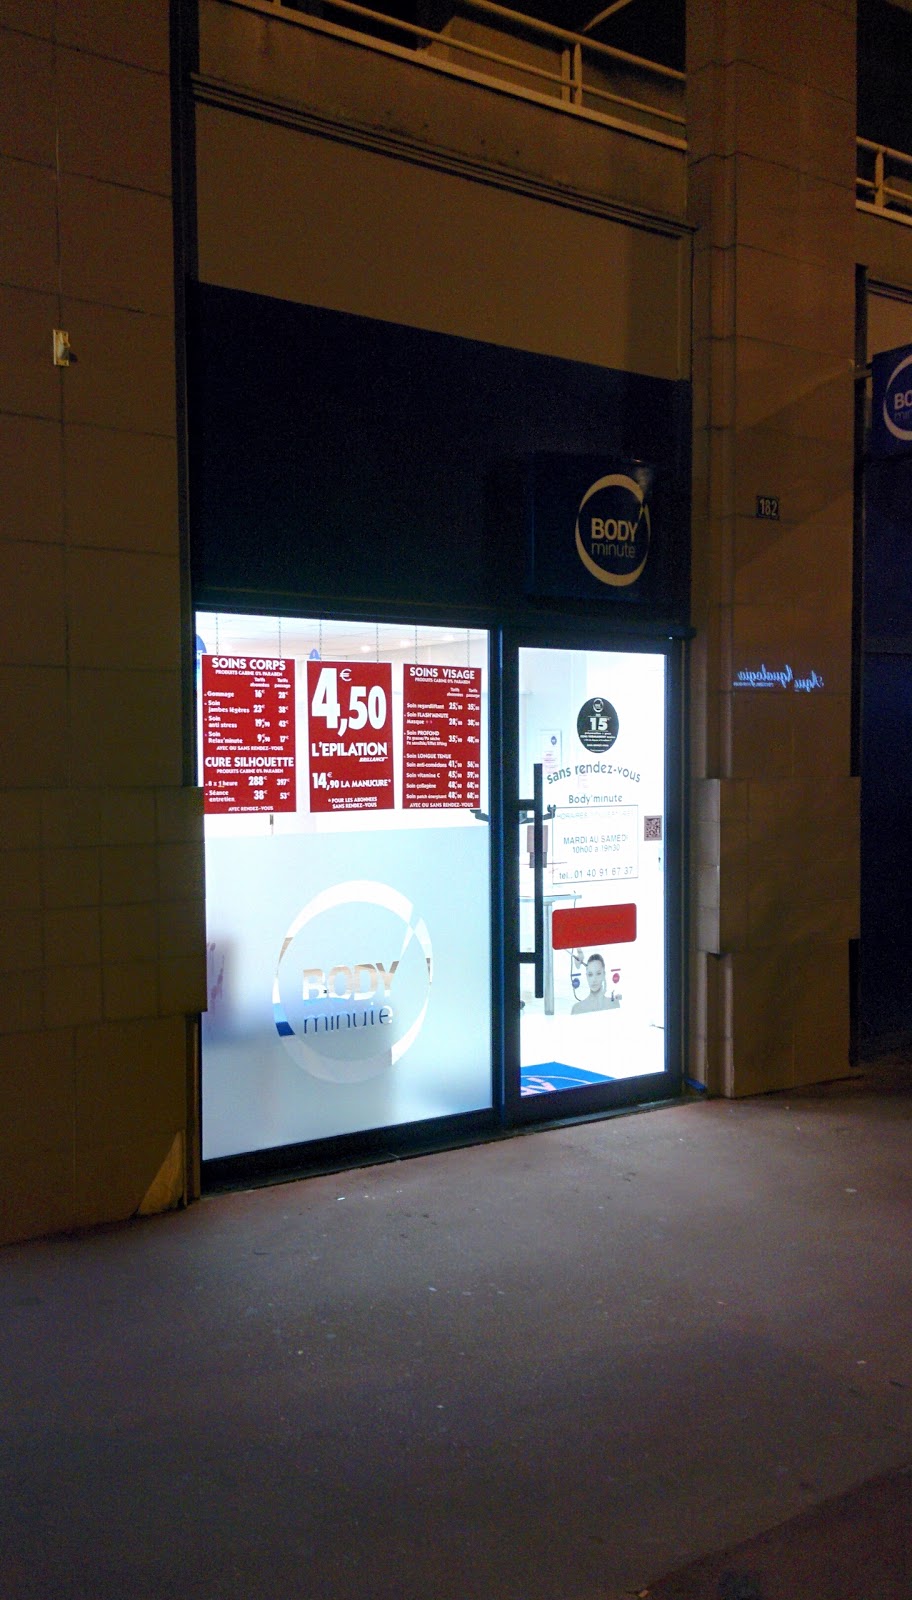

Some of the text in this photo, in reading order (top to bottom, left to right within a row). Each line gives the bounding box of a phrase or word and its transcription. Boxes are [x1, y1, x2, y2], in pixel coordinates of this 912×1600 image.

[592, 518, 638, 542] BODY
[592, 540, 636, 558] minute
[212, 658, 286, 670] SOINS CORPS
[410, 667, 475, 679] SOINS VISAGE
[312, 742, 387, 757] L'EPILATION
[205, 757, 294, 767] CURE SILHOUETTE
[547, 761, 640, 784] sans rendez-vous
[341, 780, 350, 788] LA
[569, 794, 623, 805] Body'minute
[564, 836, 588, 844] MARDI
[601, 834, 628, 843] SAMEDI
[574, 870, 582, 878] 01
[587, 869, 596, 877] 40
[599, 868, 608, 876] 91
[624, 866, 633, 875] 37
[303, 960, 399, 1000] BODY
[304, 1002, 394, 1034] minute
